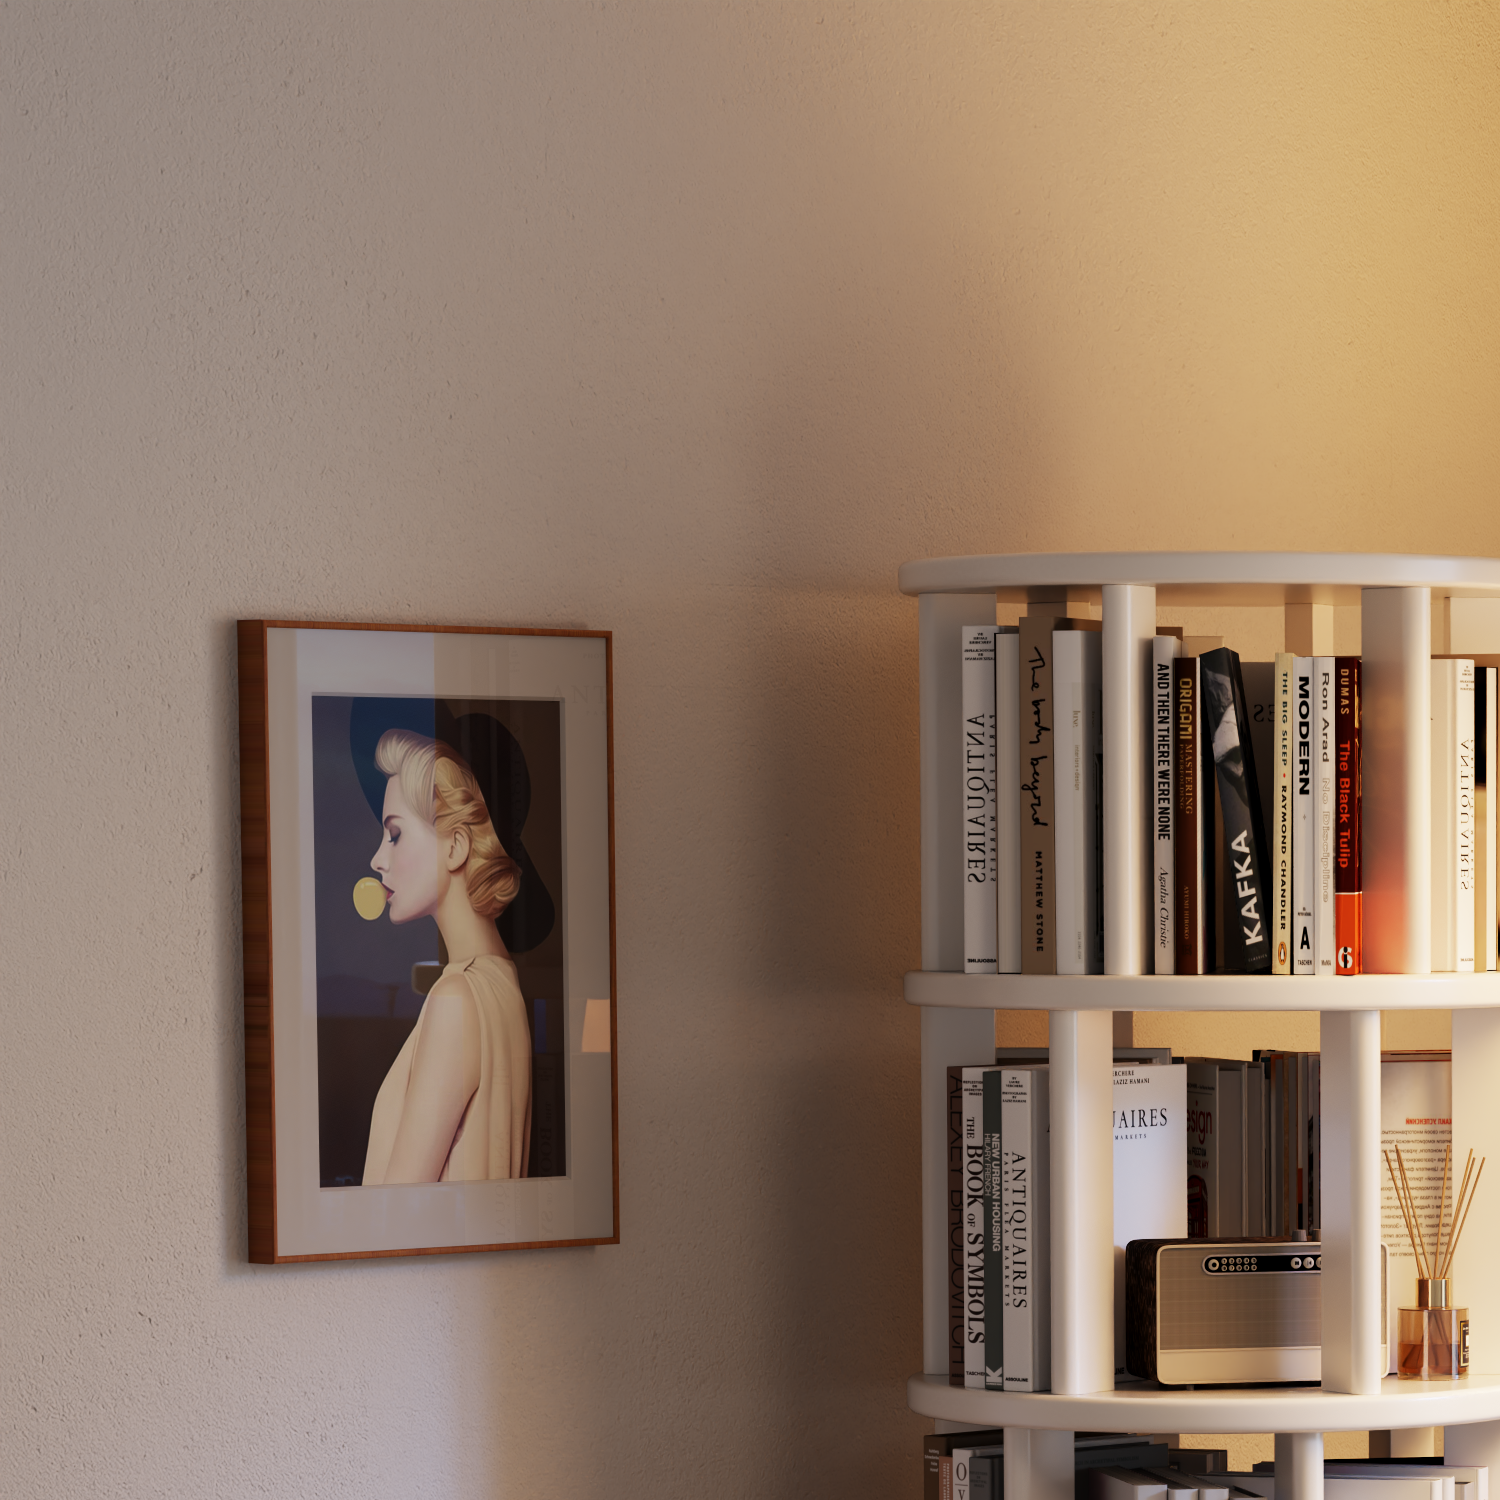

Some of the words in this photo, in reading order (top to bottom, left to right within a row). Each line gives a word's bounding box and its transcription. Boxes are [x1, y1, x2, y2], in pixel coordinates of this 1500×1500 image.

[1028, 646, 1045, 691] The
[1157, 664, 1170, 689] AND
[1157, 692, 1170, 724] THEN
[1179, 678, 1193, 739] ORIGAMI
[1322, 672, 1330, 710] Ron
[1341, 669, 1350, 714] DUMAS
[1029, 699, 1051, 744] body
[1299, 676, 1310, 795] MODERN
[1322, 717, 1330, 762] Arad
[1158, 727, 1170, 766] THERE
[1340, 740, 1351, 772] The
[1021, 756, 1048, 826] beyond
[1158, 769, 1170, 804] WERE
[1185, 744, 1193, 814] MASTERING
[1340, 778, 1351, 824] Black
[1158, 807, 1170, 840] NONE
[1338, 829, 1351, 868] Tulip
[1035, 851, 1043, 908] MATTHEW
[1158, 867, 1169, 904] Agatha
[1231, 829, 1263, 946] KAFKA
[1036, 914, 1044, 952] STONE
[1160, 907, 1170, 948] Christie
[967, 1116, 975, 1139] THE
[992, 1133, 1000, 1159] NEW
[967, 1144, 984, 1208] BOOK
[992, 1161, 1001, 1199] URBAN
[967, 1213, 976, 1227] OF
[992, 1202, 1001, 1252] HOUSING
[1008, 1152, 1027, 1308] ANTIQUAIRES
[967, 1233, 985, 1344] SYMBOLS
